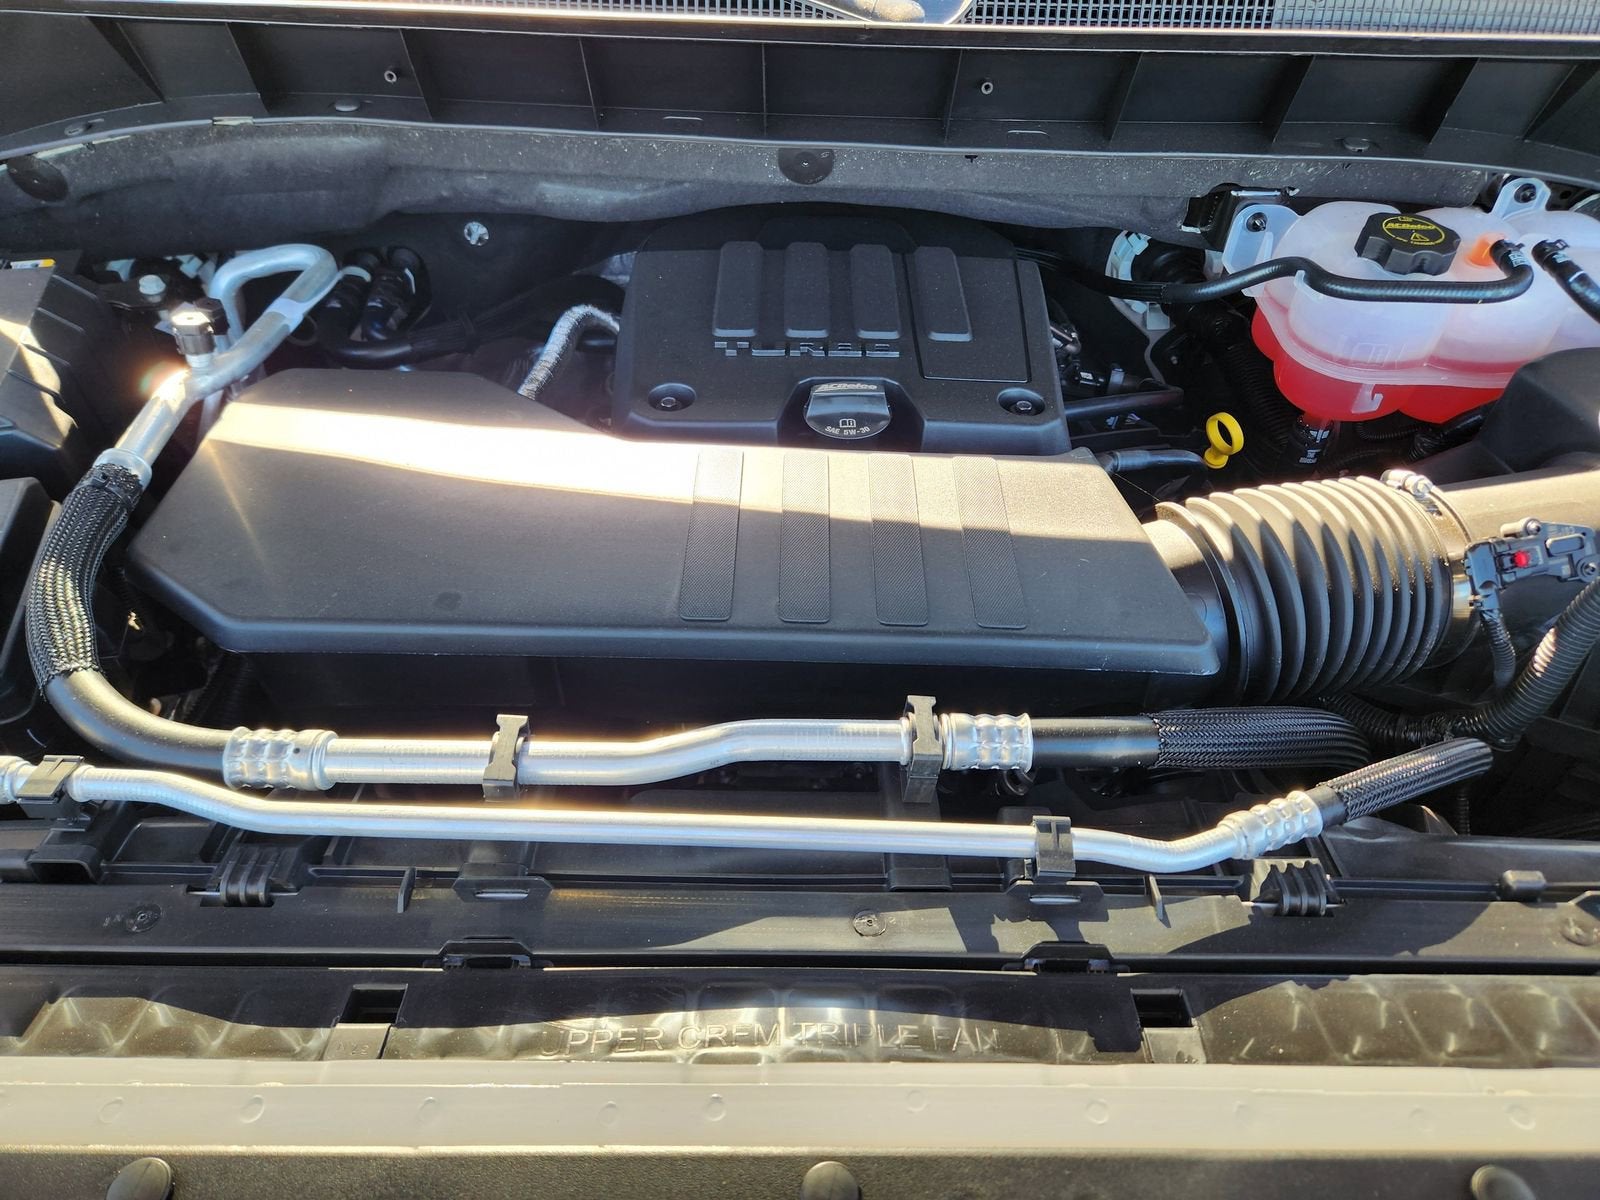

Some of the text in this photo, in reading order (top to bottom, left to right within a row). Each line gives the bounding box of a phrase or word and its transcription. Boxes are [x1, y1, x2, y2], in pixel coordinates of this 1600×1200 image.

[824, 425, 871, 435] SAE 5W-30
[540, 1026, 664, 1057] UPPER
[793, 1021, 921, 1049] TRIPLE
[932, 1025, 1001, 1053] FAN
